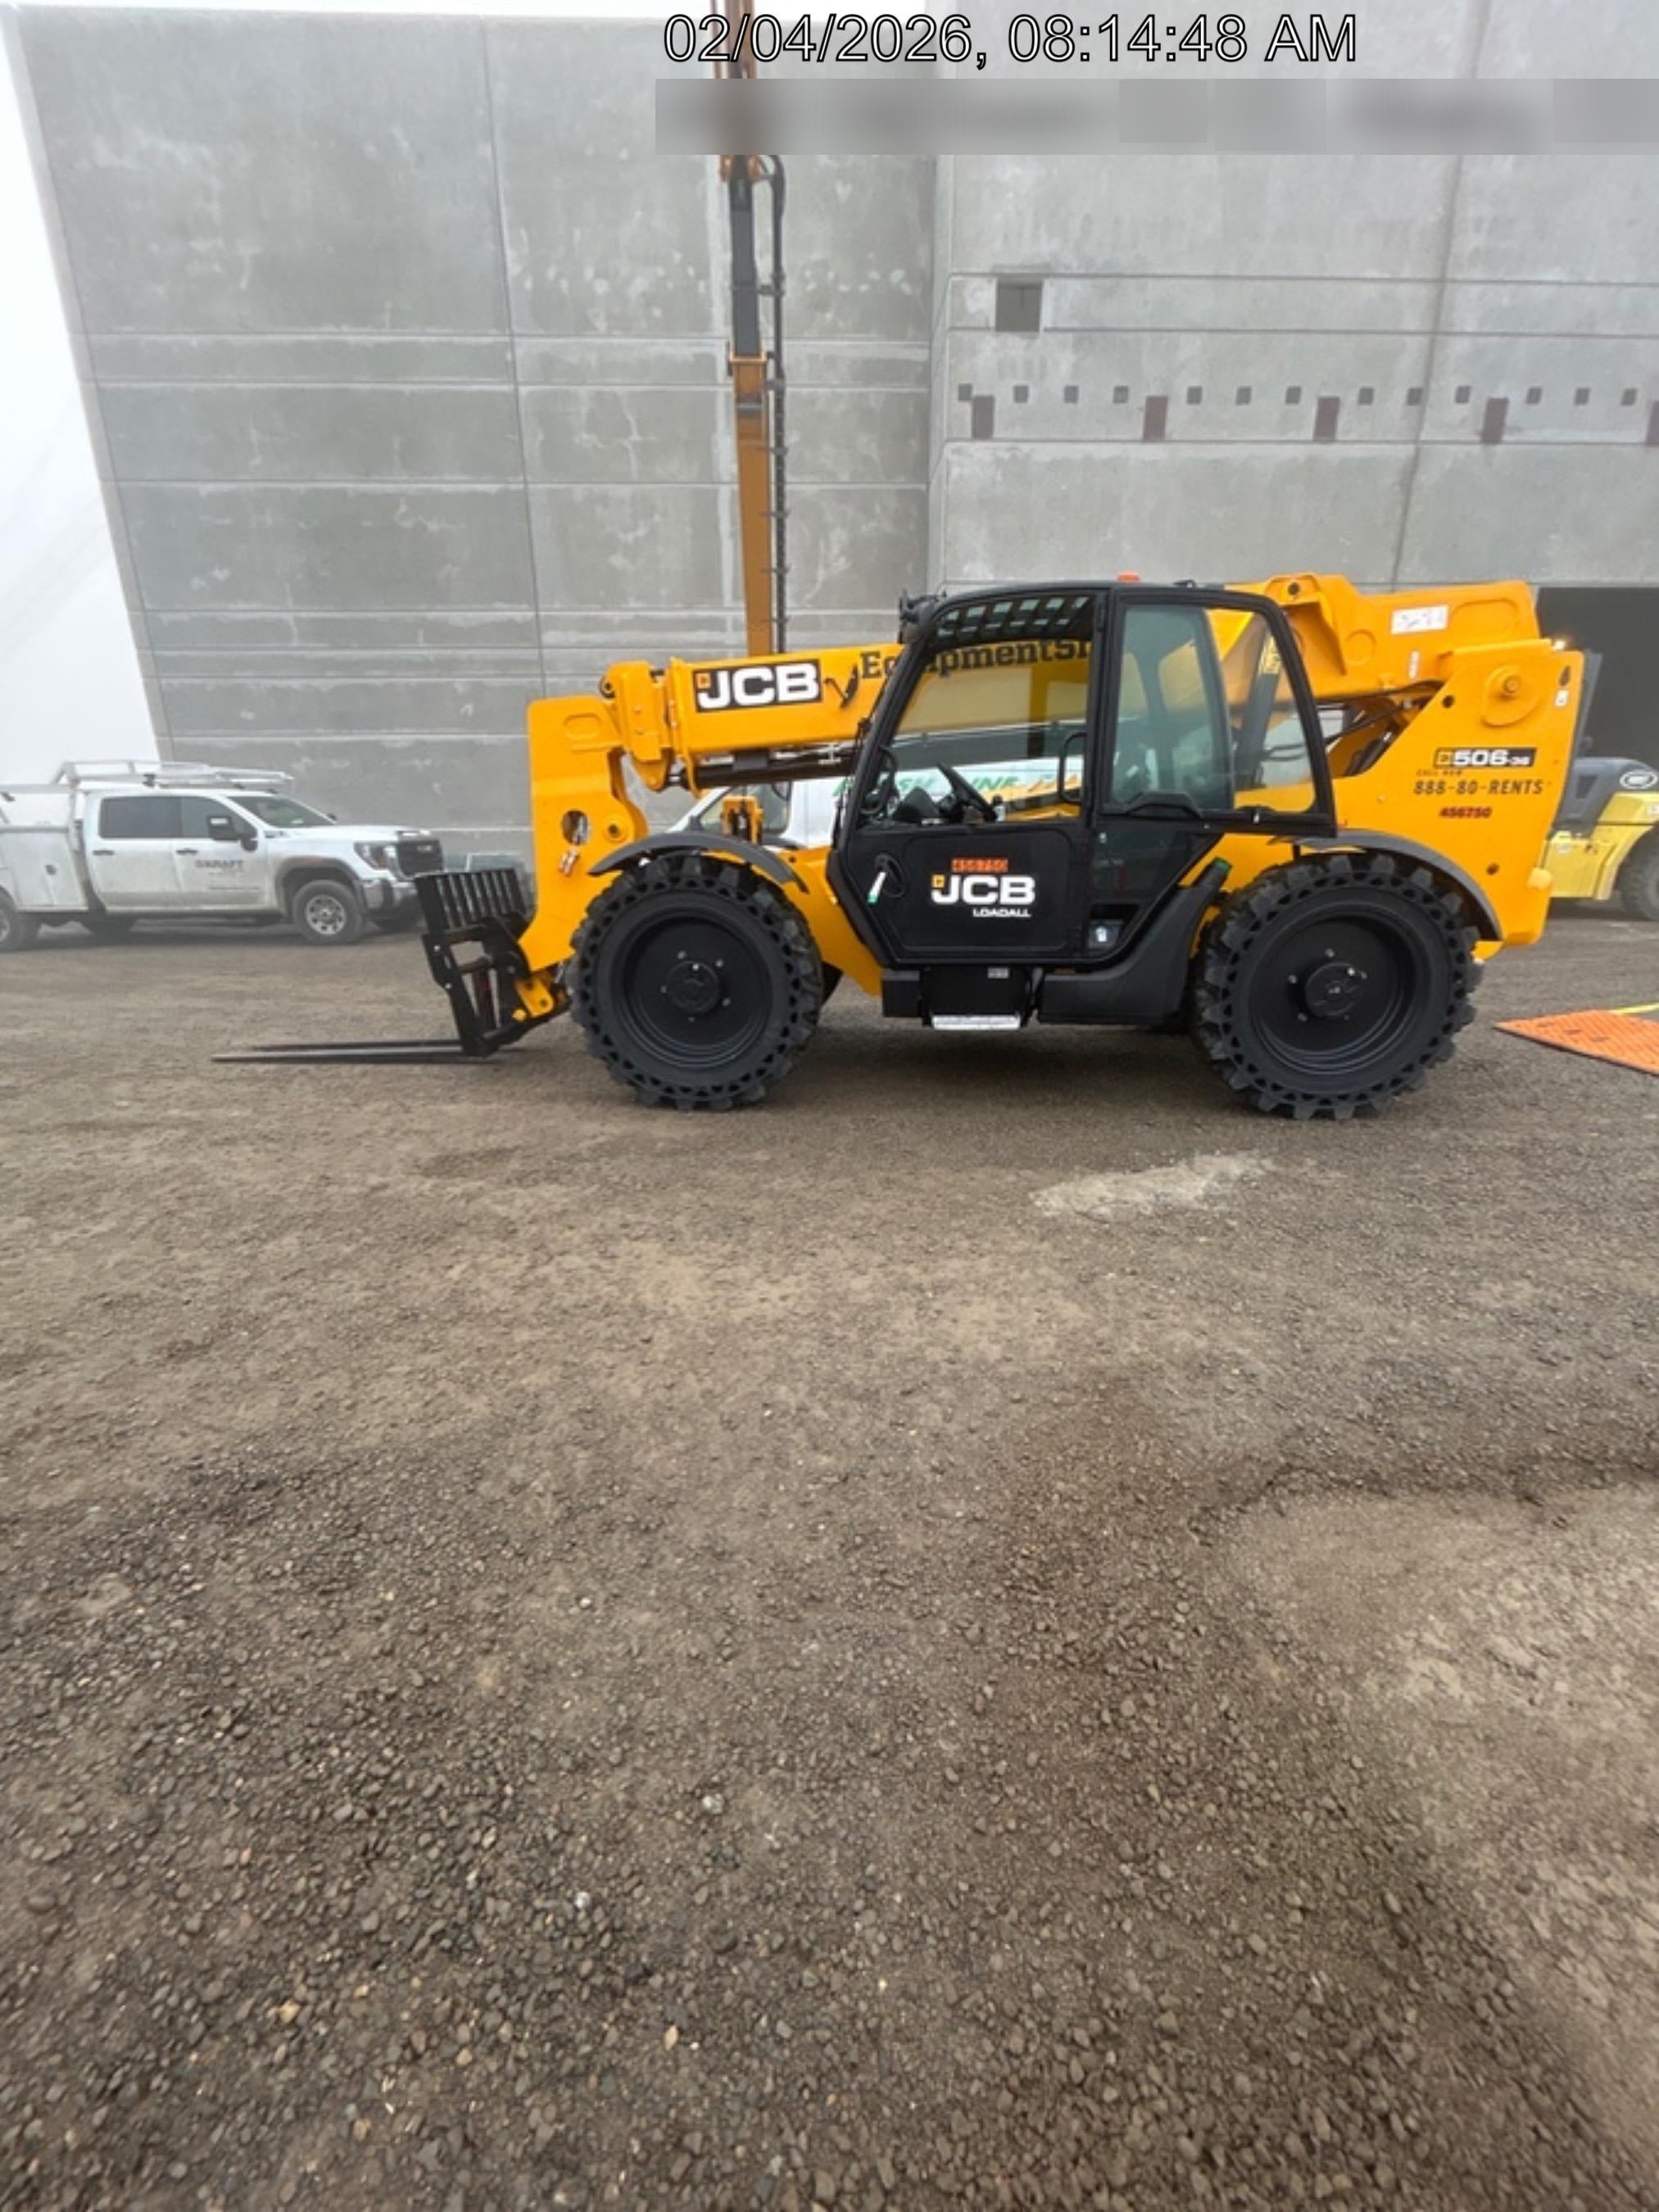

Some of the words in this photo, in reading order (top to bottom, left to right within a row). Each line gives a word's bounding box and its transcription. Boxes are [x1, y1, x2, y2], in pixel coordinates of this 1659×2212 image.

[696, 663, 819, 709] JCB
[931, 874, 1036, 904] JCB
[972, 908, 1031, 918] LOADALL
